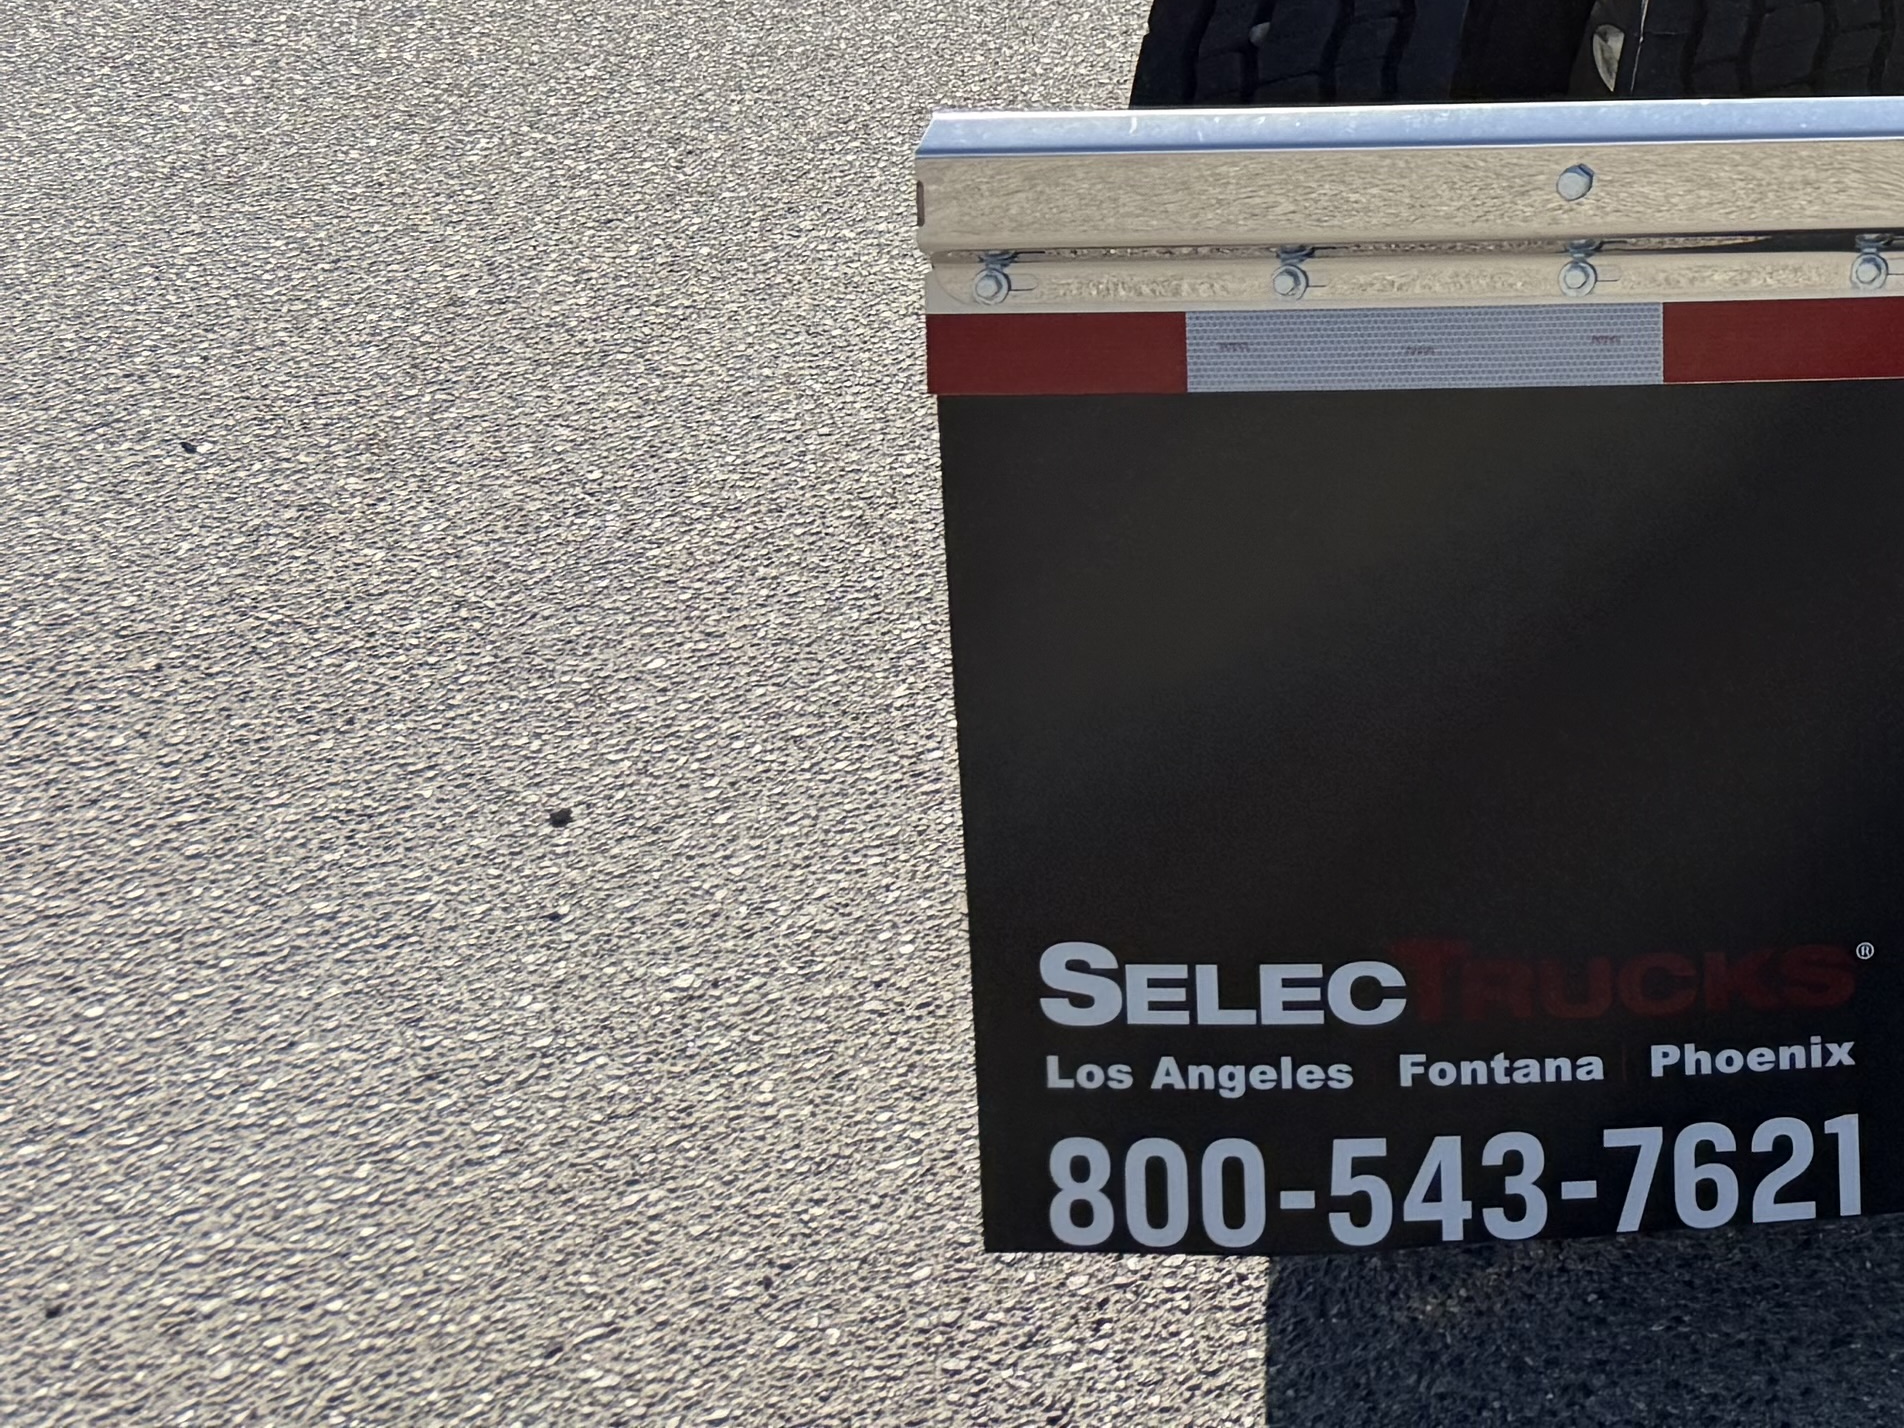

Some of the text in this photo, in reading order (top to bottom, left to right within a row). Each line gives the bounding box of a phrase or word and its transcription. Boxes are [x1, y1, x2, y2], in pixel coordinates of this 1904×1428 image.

[1046, 1036, 1856, 1100] Los Angeles Fontana Phoenix
[1047, 1113, 1864, 1249] 800-543-7621
